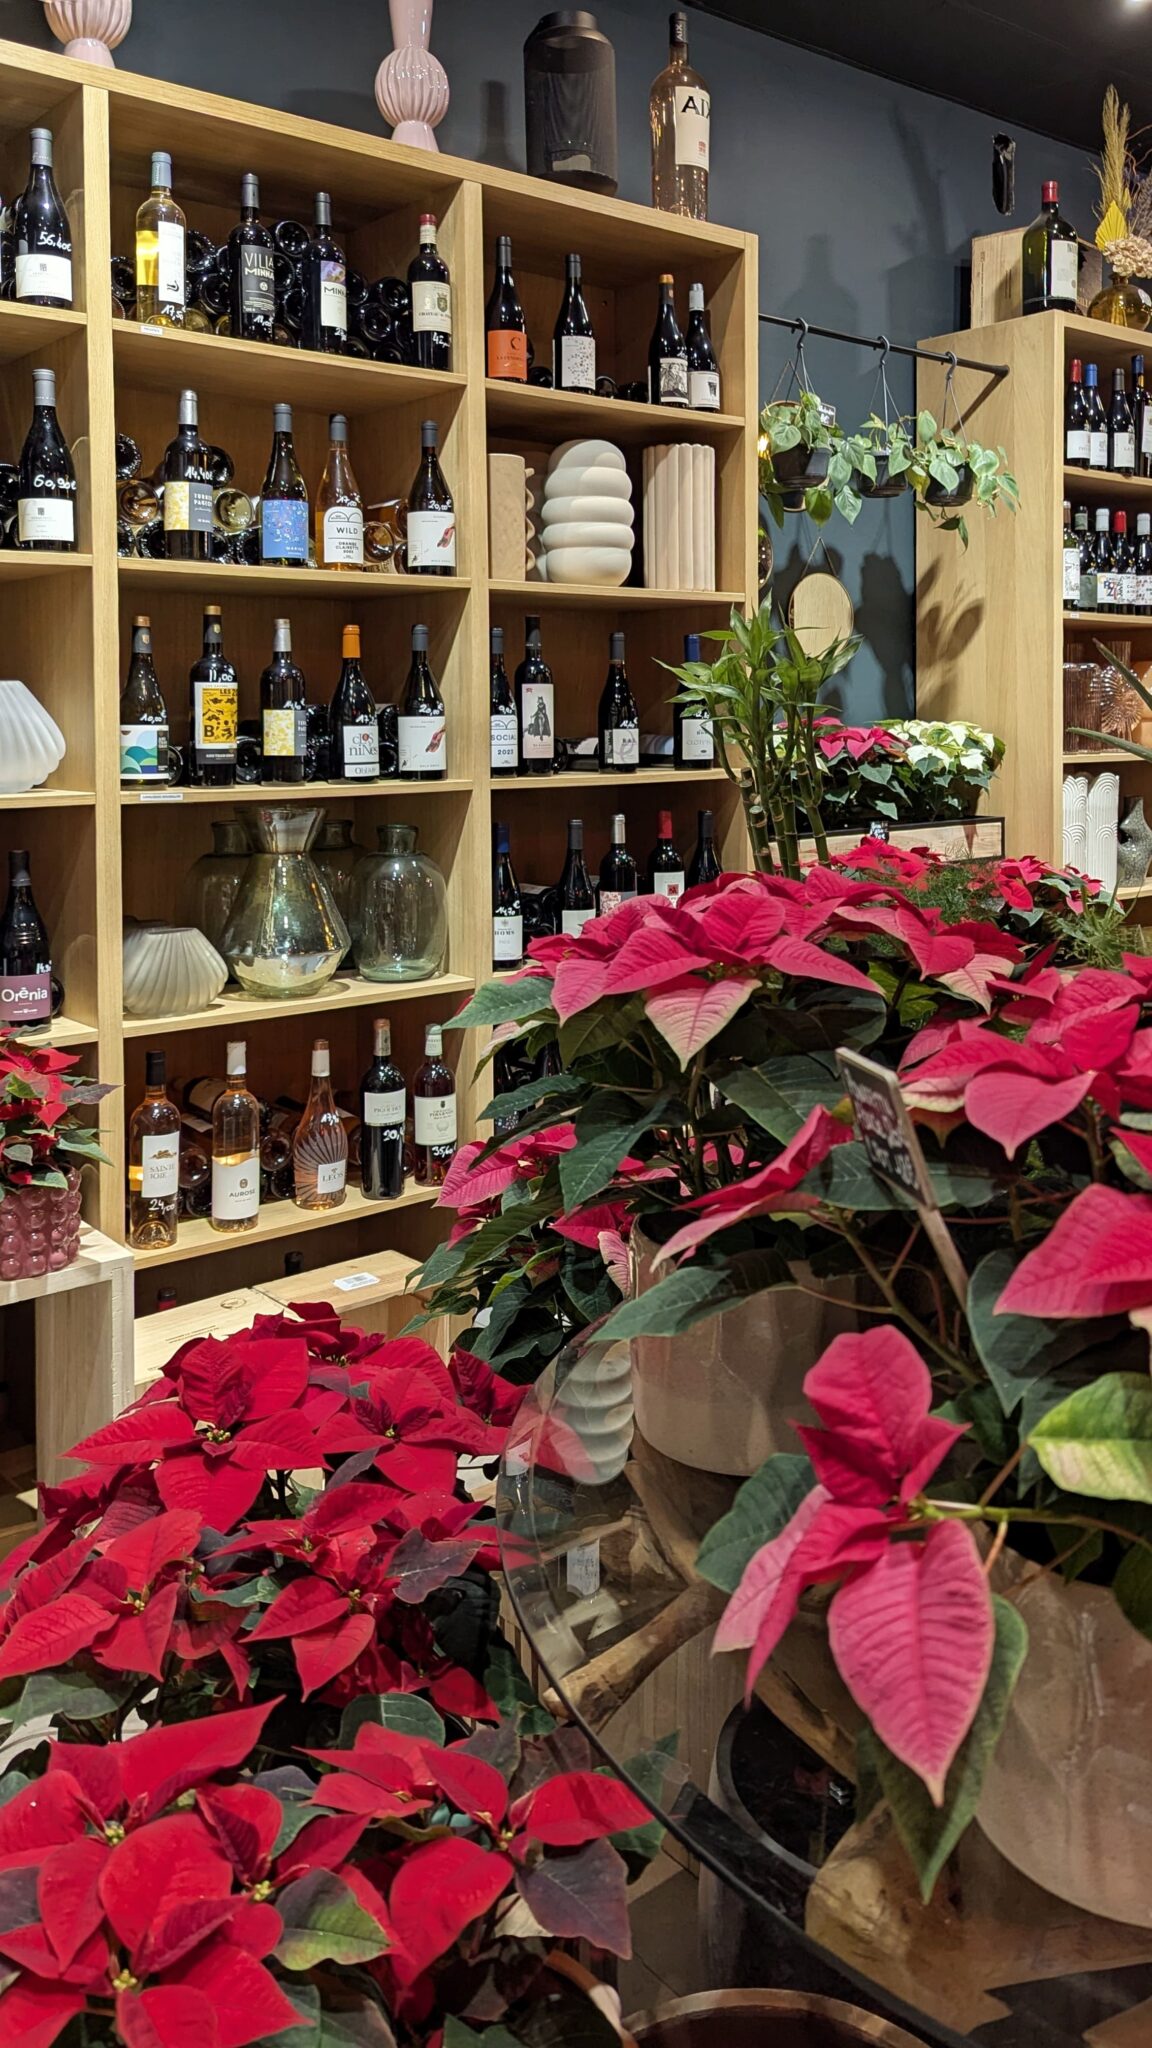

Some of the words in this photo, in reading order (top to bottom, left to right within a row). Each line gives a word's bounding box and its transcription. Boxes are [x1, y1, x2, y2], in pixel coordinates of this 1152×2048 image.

[244, 252, 274, 272] VILLA
[336, 526, 358, 535] WILD
[229, 1188, 256, 1198] AUROSE
